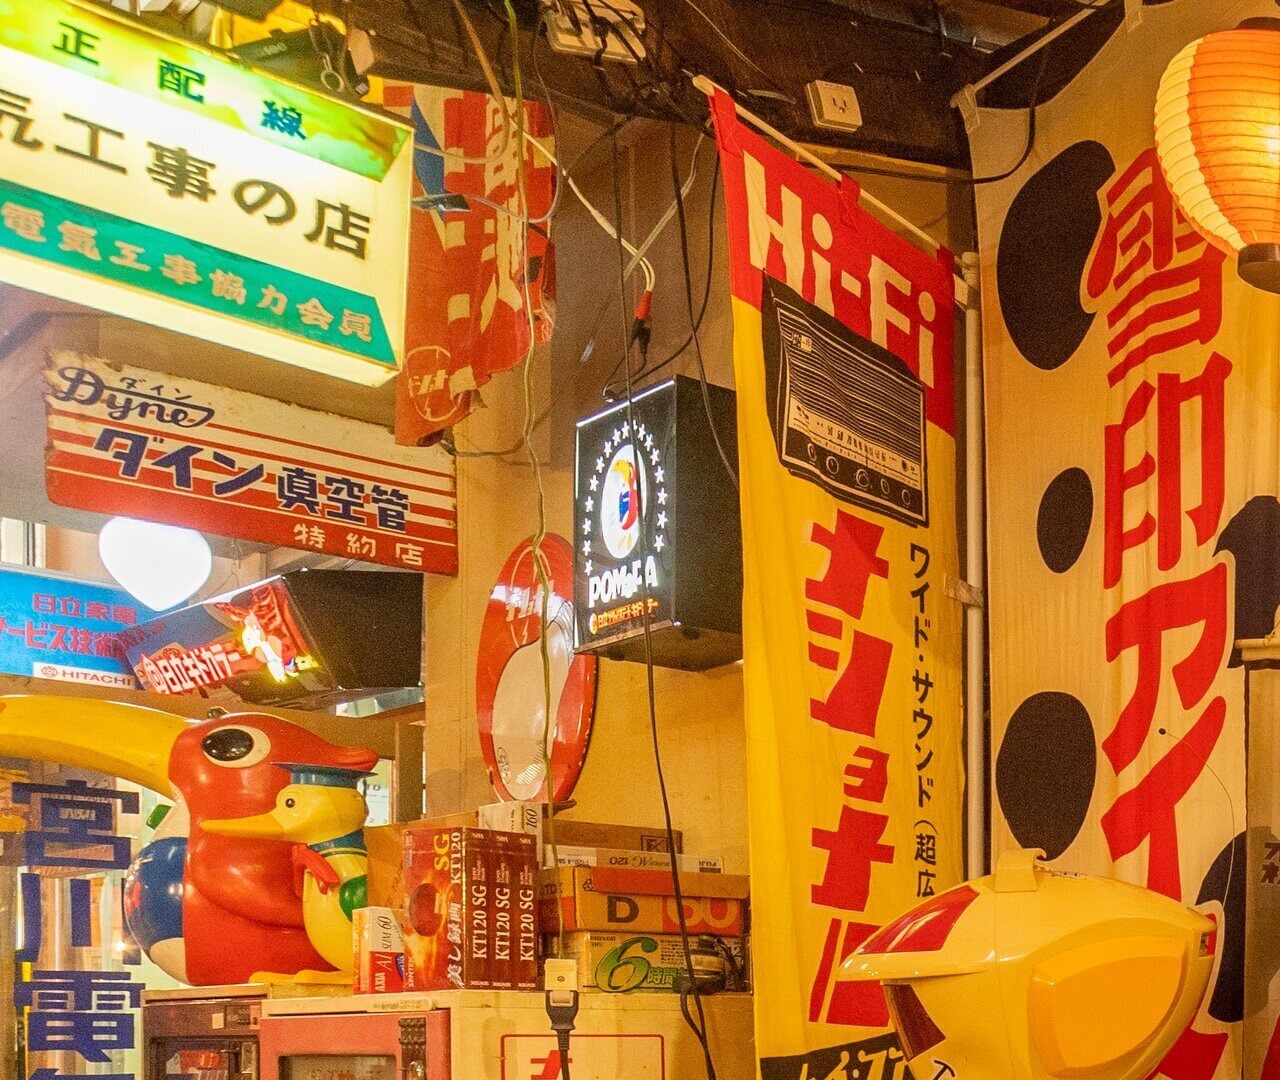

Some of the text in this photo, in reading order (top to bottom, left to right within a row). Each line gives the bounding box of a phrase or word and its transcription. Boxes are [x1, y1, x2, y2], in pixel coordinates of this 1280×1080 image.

[53, 20, 307, 140] 正配線
[2, 205, 374, 343] 電気工事協力会員
[742, 150, 937, 390] Hi-Fi
[56, 365, 215, 428] Dyne
[118, 375, 193, 402] ダイン
[93, 428, 409, 534] ダイン真空管
[292, 523, 425, 567] 特約店
[62, 670, 131, 686] HITACHI
[434, 833, 449, 871] SG
[451, 831, 461, 885] KT120
[472, 885, 488, 960] KT120 SG
[496, 887, 510, 961] KT120 SG
[519, 889, 534, 962] KT120 SG
[607, 895, 640, 924] D
